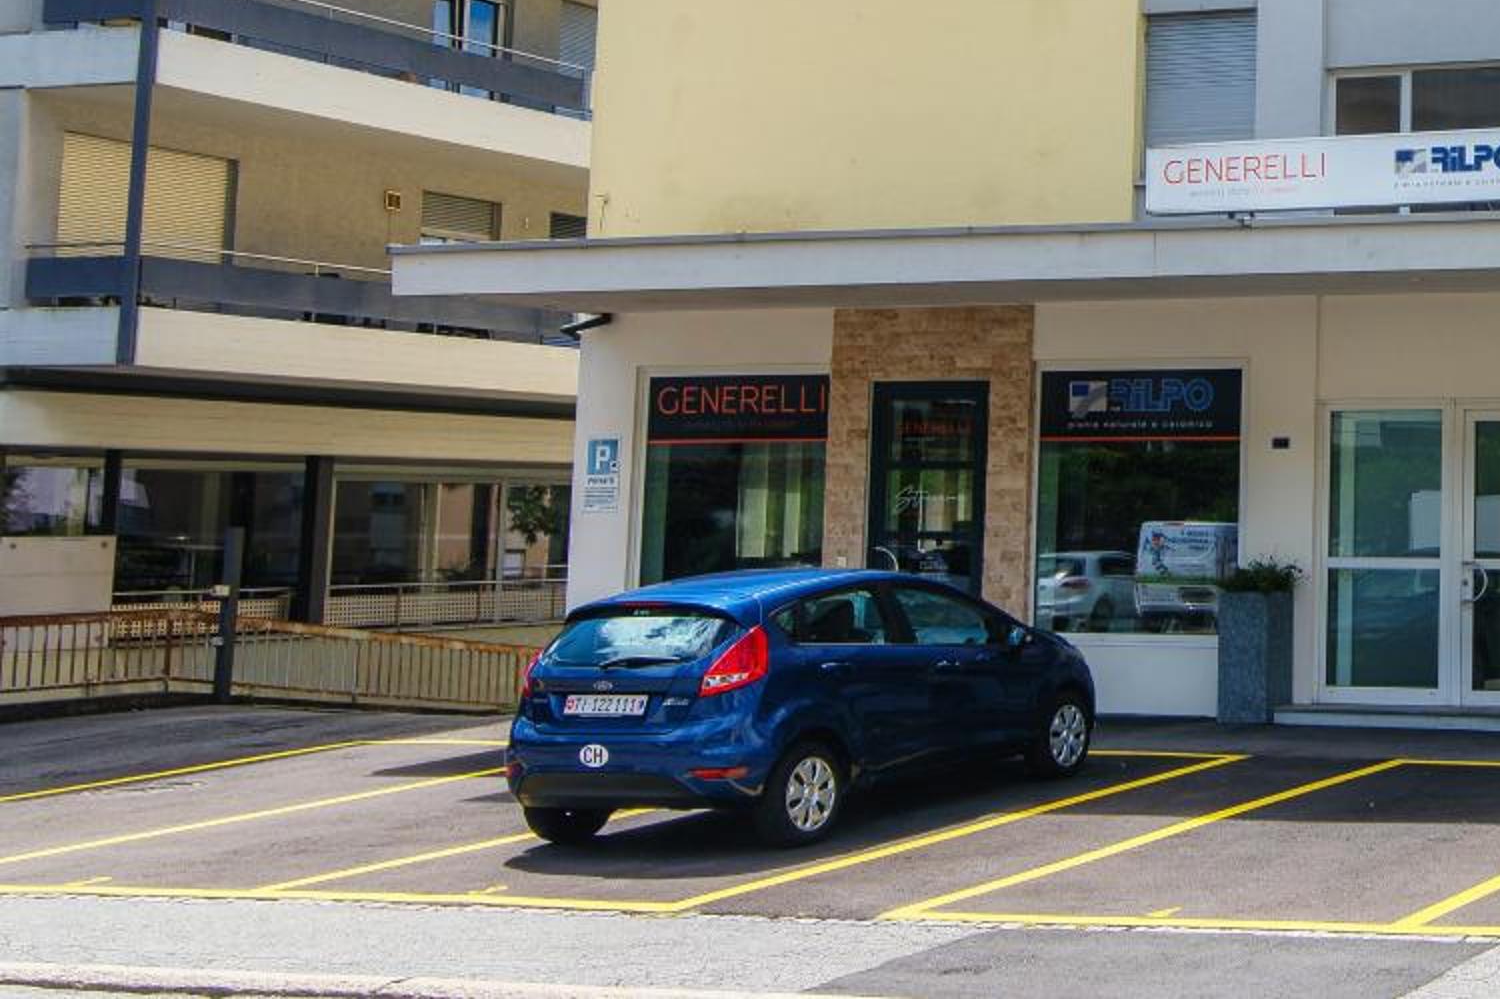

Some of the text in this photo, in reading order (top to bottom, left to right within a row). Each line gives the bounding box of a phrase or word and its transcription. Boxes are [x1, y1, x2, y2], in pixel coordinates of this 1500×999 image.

[1163, 152, 1326, 184] GENERELLI
[656, 384, 826, 415] GENERELLI
[595, 445, 611, 470] P
[583, 748, 603, 764] CH
